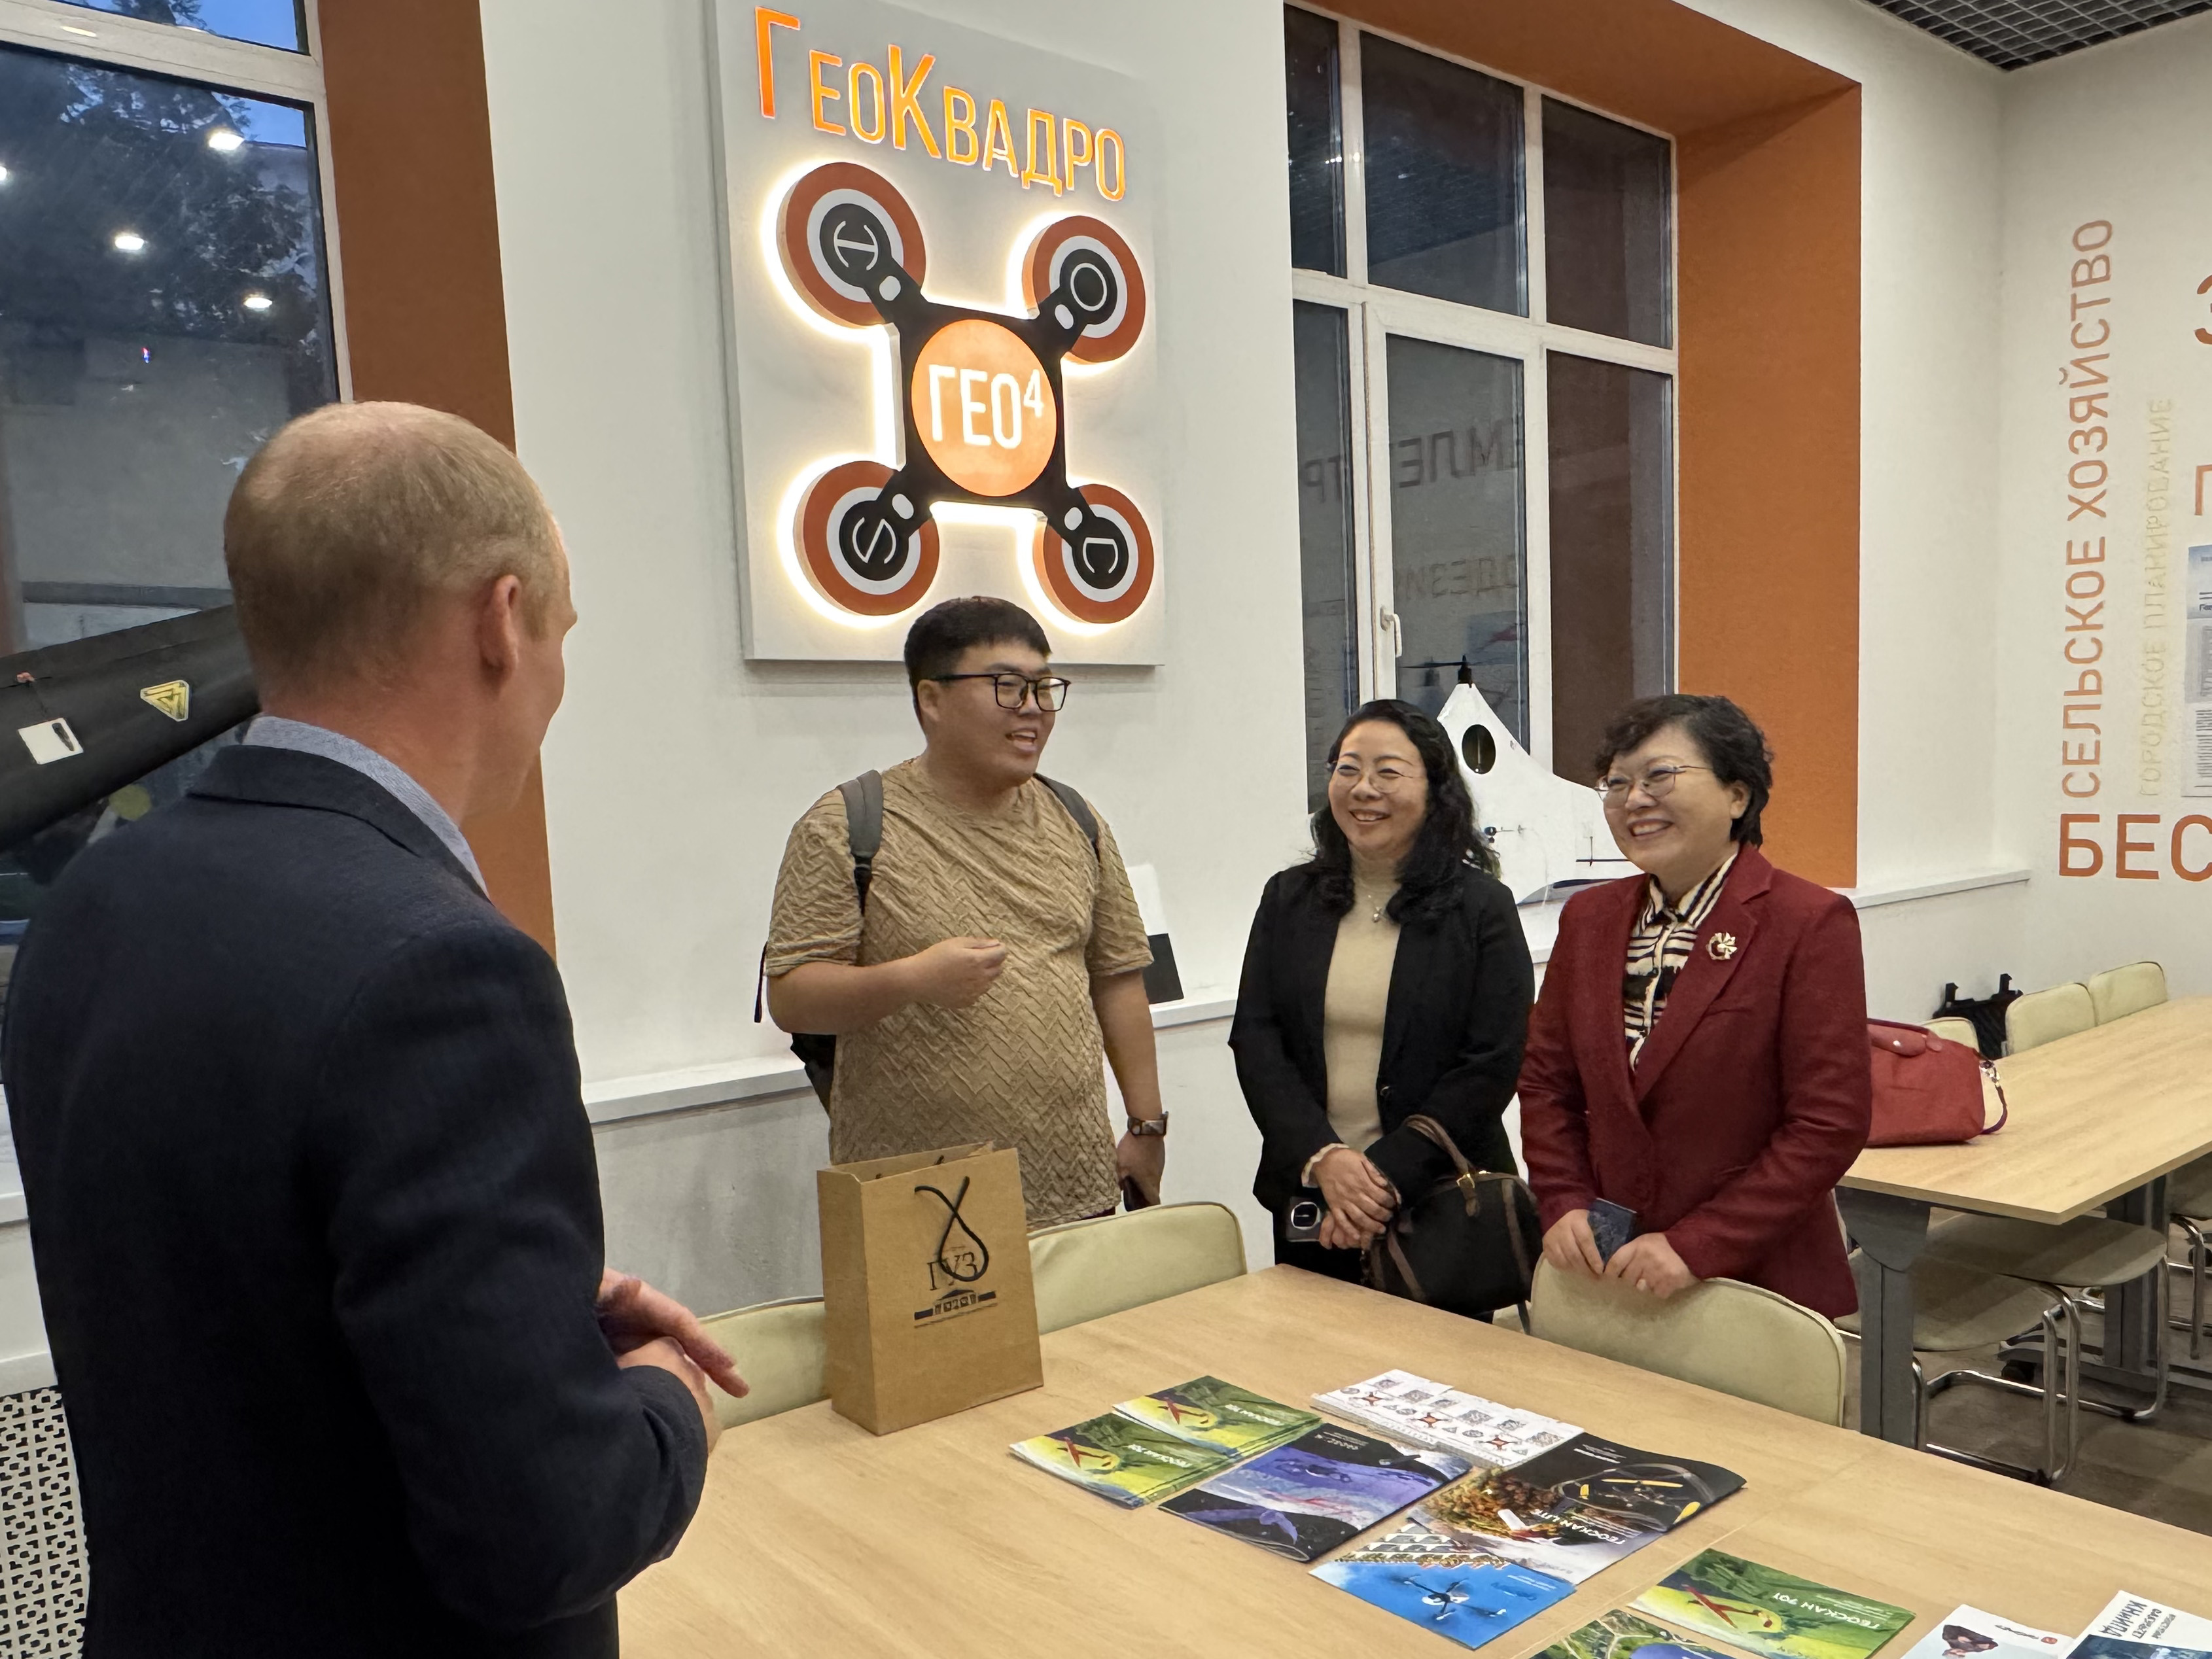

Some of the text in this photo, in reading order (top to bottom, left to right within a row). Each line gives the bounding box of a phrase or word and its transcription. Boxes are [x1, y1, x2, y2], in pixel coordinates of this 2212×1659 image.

[2059, 220, 2114, 798] СЕЛЬСКОЕ ХОЗЯЙСТВО
[2139, 398, 2173, 797] ГОРОДСКОЕ ПЛАНИРОВАНИЕ
[2059, 813, 2212, 882] БЕС
